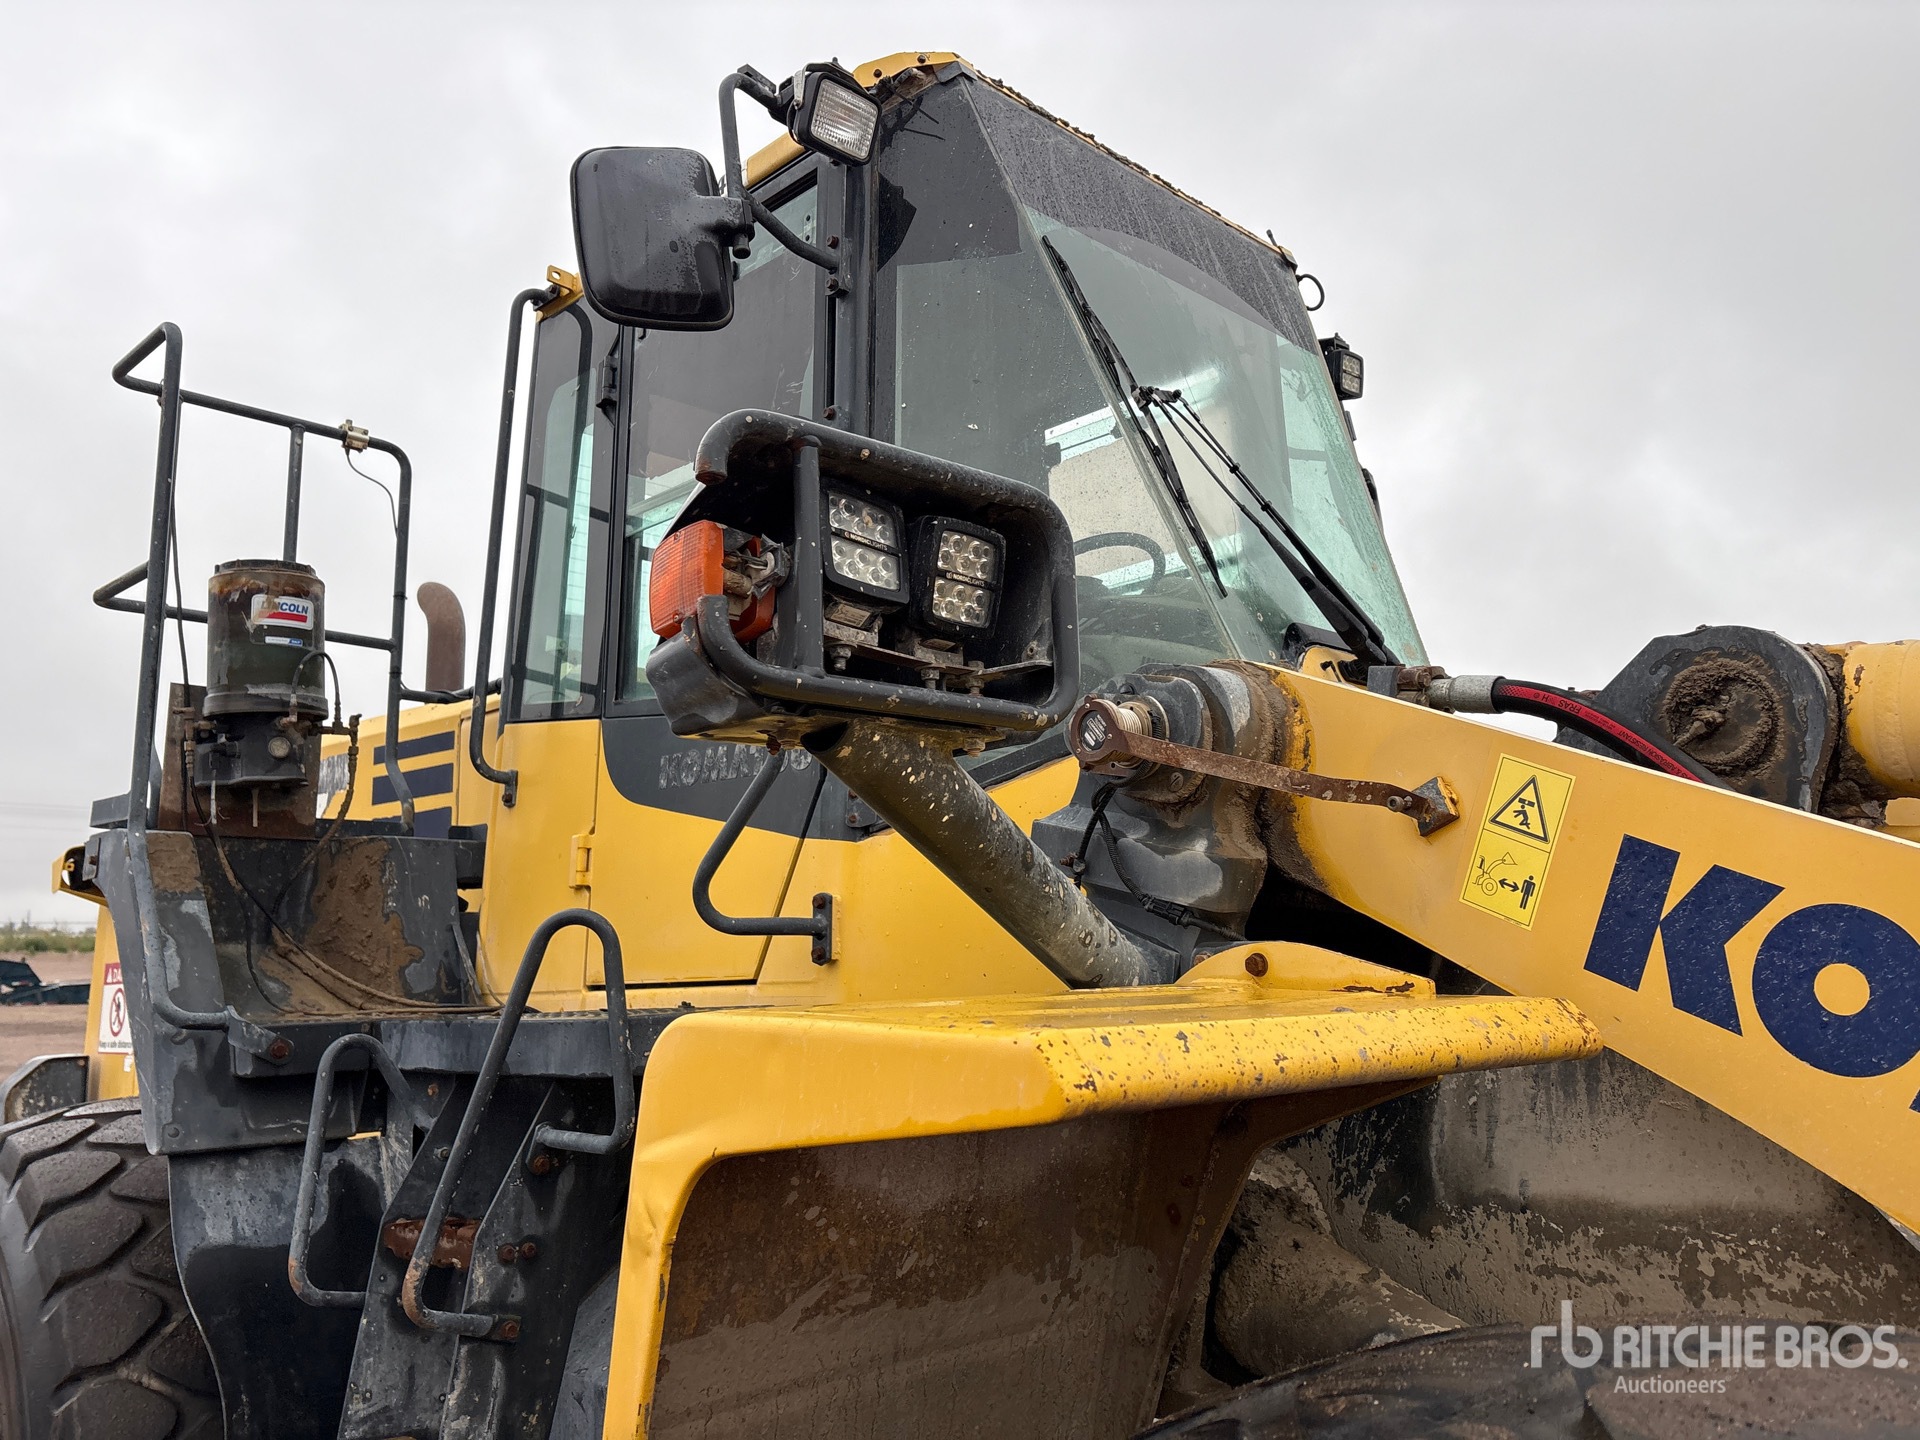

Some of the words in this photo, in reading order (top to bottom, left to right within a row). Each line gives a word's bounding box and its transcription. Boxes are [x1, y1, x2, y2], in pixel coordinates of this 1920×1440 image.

[261, 601, 309, 614] LCOLN
[1558, 699, 1582, 714] FRAS
[1617, 730, 1649, 752] RESISTANT
[658, 744, 813, 790] KOMATU
[1646, 748, 1677, 771] ABRASION
[1584, 834, 1920, 1113] KO
